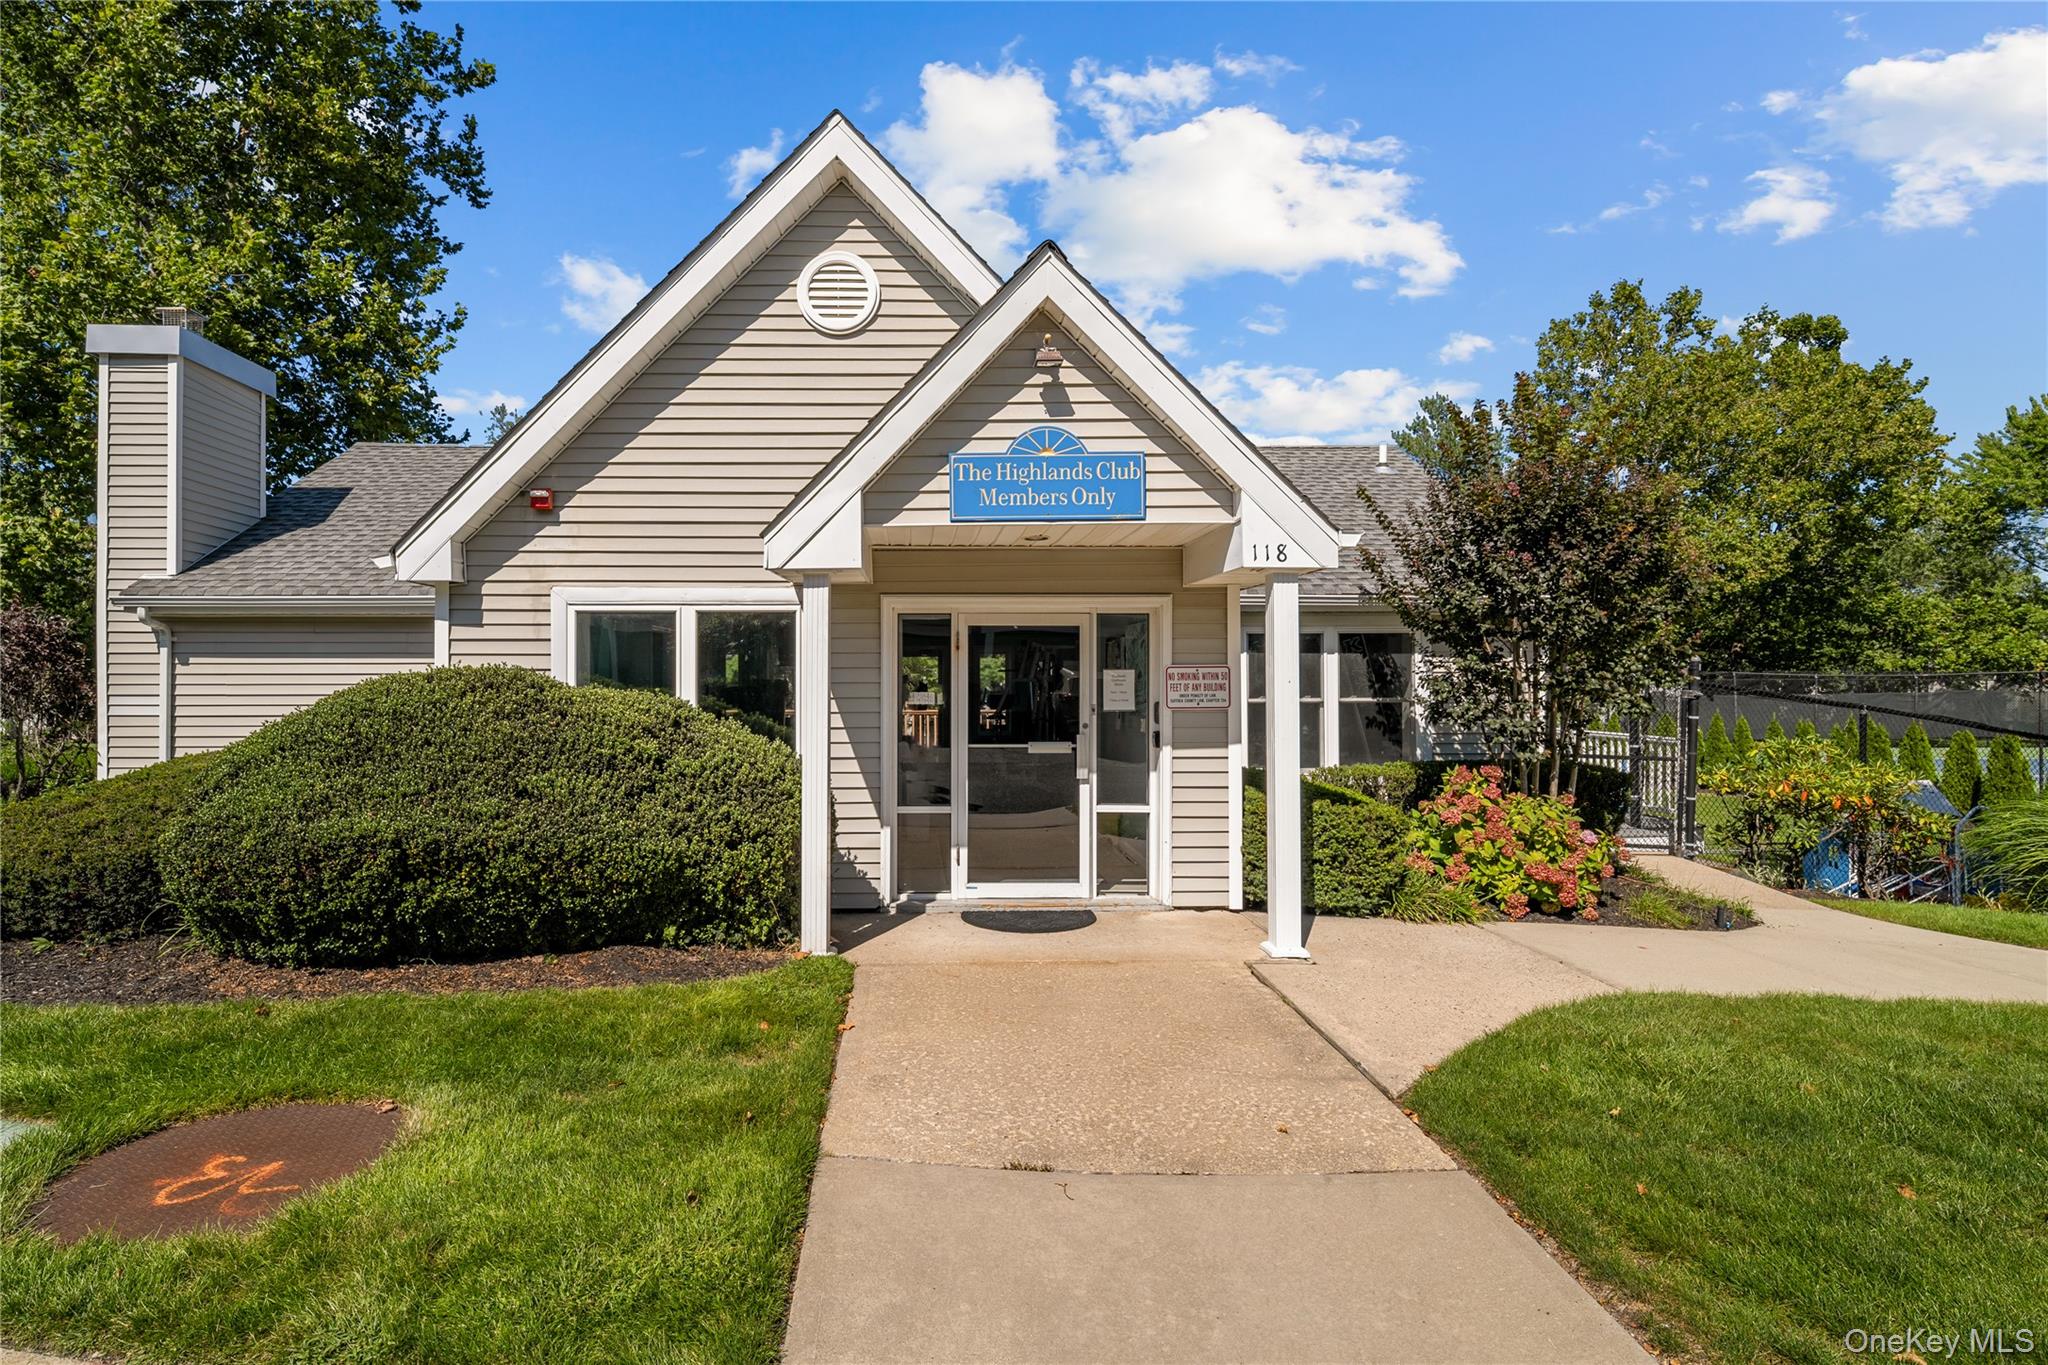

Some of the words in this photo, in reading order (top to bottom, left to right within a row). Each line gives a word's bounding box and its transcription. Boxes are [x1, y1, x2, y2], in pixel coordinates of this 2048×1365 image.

[953, 462, 992, 482] The
[996, 461, 1093, 486] Highlands
[1096, 460, 1141, 481] Club
[979, 487, 1068, 507] Members
[1071, 486, 1116, 510] Only
[1252, 543, 1288, 563] 118
[1168, 672, 1175, 681] NO
[1177, 672, 1200, 681] SMOKING
[1201, 672, 1219, 681] WITHIN
[1220, 672, 1228, 681] 50
[1169, 682, 1182, 692] FEET
[1183, 682, 1190, 692] OF
[1192, 682, 1202, 692] ANY
[1203, 682, 1226, 692] BUILDING
